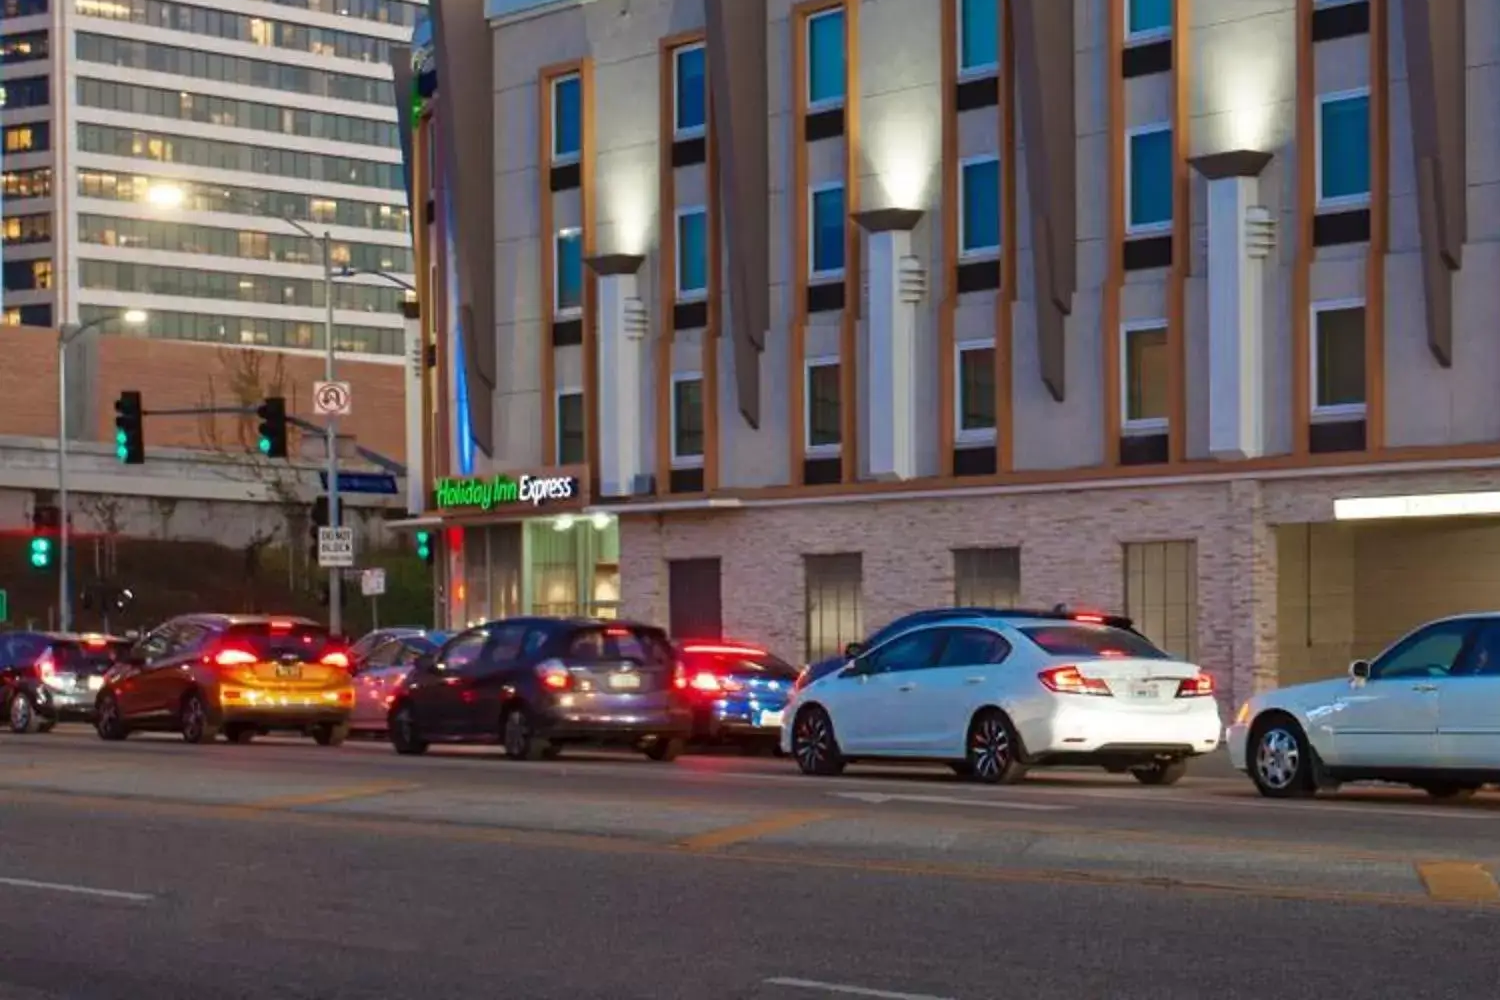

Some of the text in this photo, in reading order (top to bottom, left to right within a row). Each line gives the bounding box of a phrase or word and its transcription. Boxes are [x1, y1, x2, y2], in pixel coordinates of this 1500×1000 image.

[435, 474, 574, 510] Holiday Inn Express
